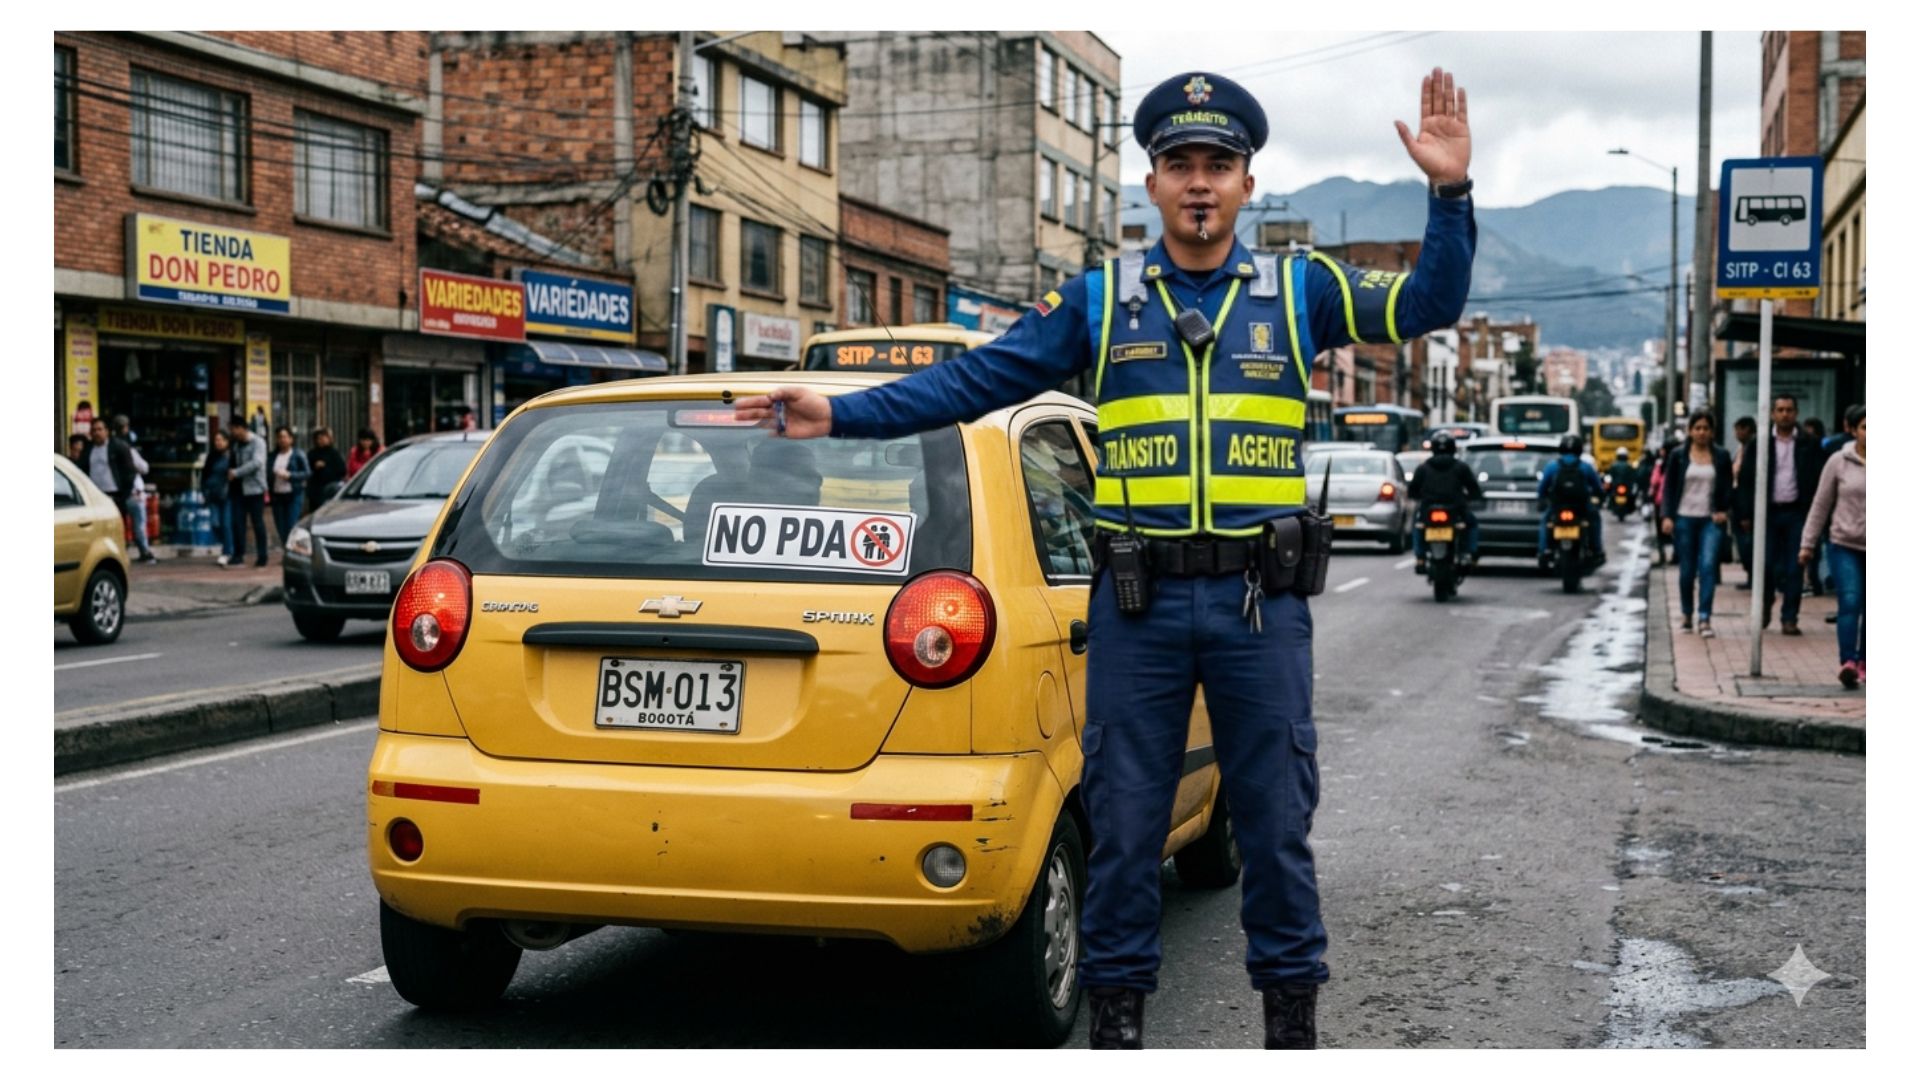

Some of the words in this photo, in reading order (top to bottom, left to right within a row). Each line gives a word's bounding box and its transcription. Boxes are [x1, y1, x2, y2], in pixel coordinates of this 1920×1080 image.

[180, 229, 254, 261] TIENDA
[149, 253, 199, 285] DON
[208, 261, 281, 294] PEDRO
[1725, 261, 1759, 279] SITP
[1792, 261, 1811, 279] 63
[425, 277, 522, 318] VARIEDADES
[526, 280, 630, 325] VARIÉDADES
[837, 345, 875, 366] SITP
[911, 345, 934, 366] 63
[1104, 432, 1178, 470] TRÁNSITO
[1227, 433, 1296, 470] AGENTE
[713, 514, 767, 555] NO
[776, 516, 847, 559] PDA
